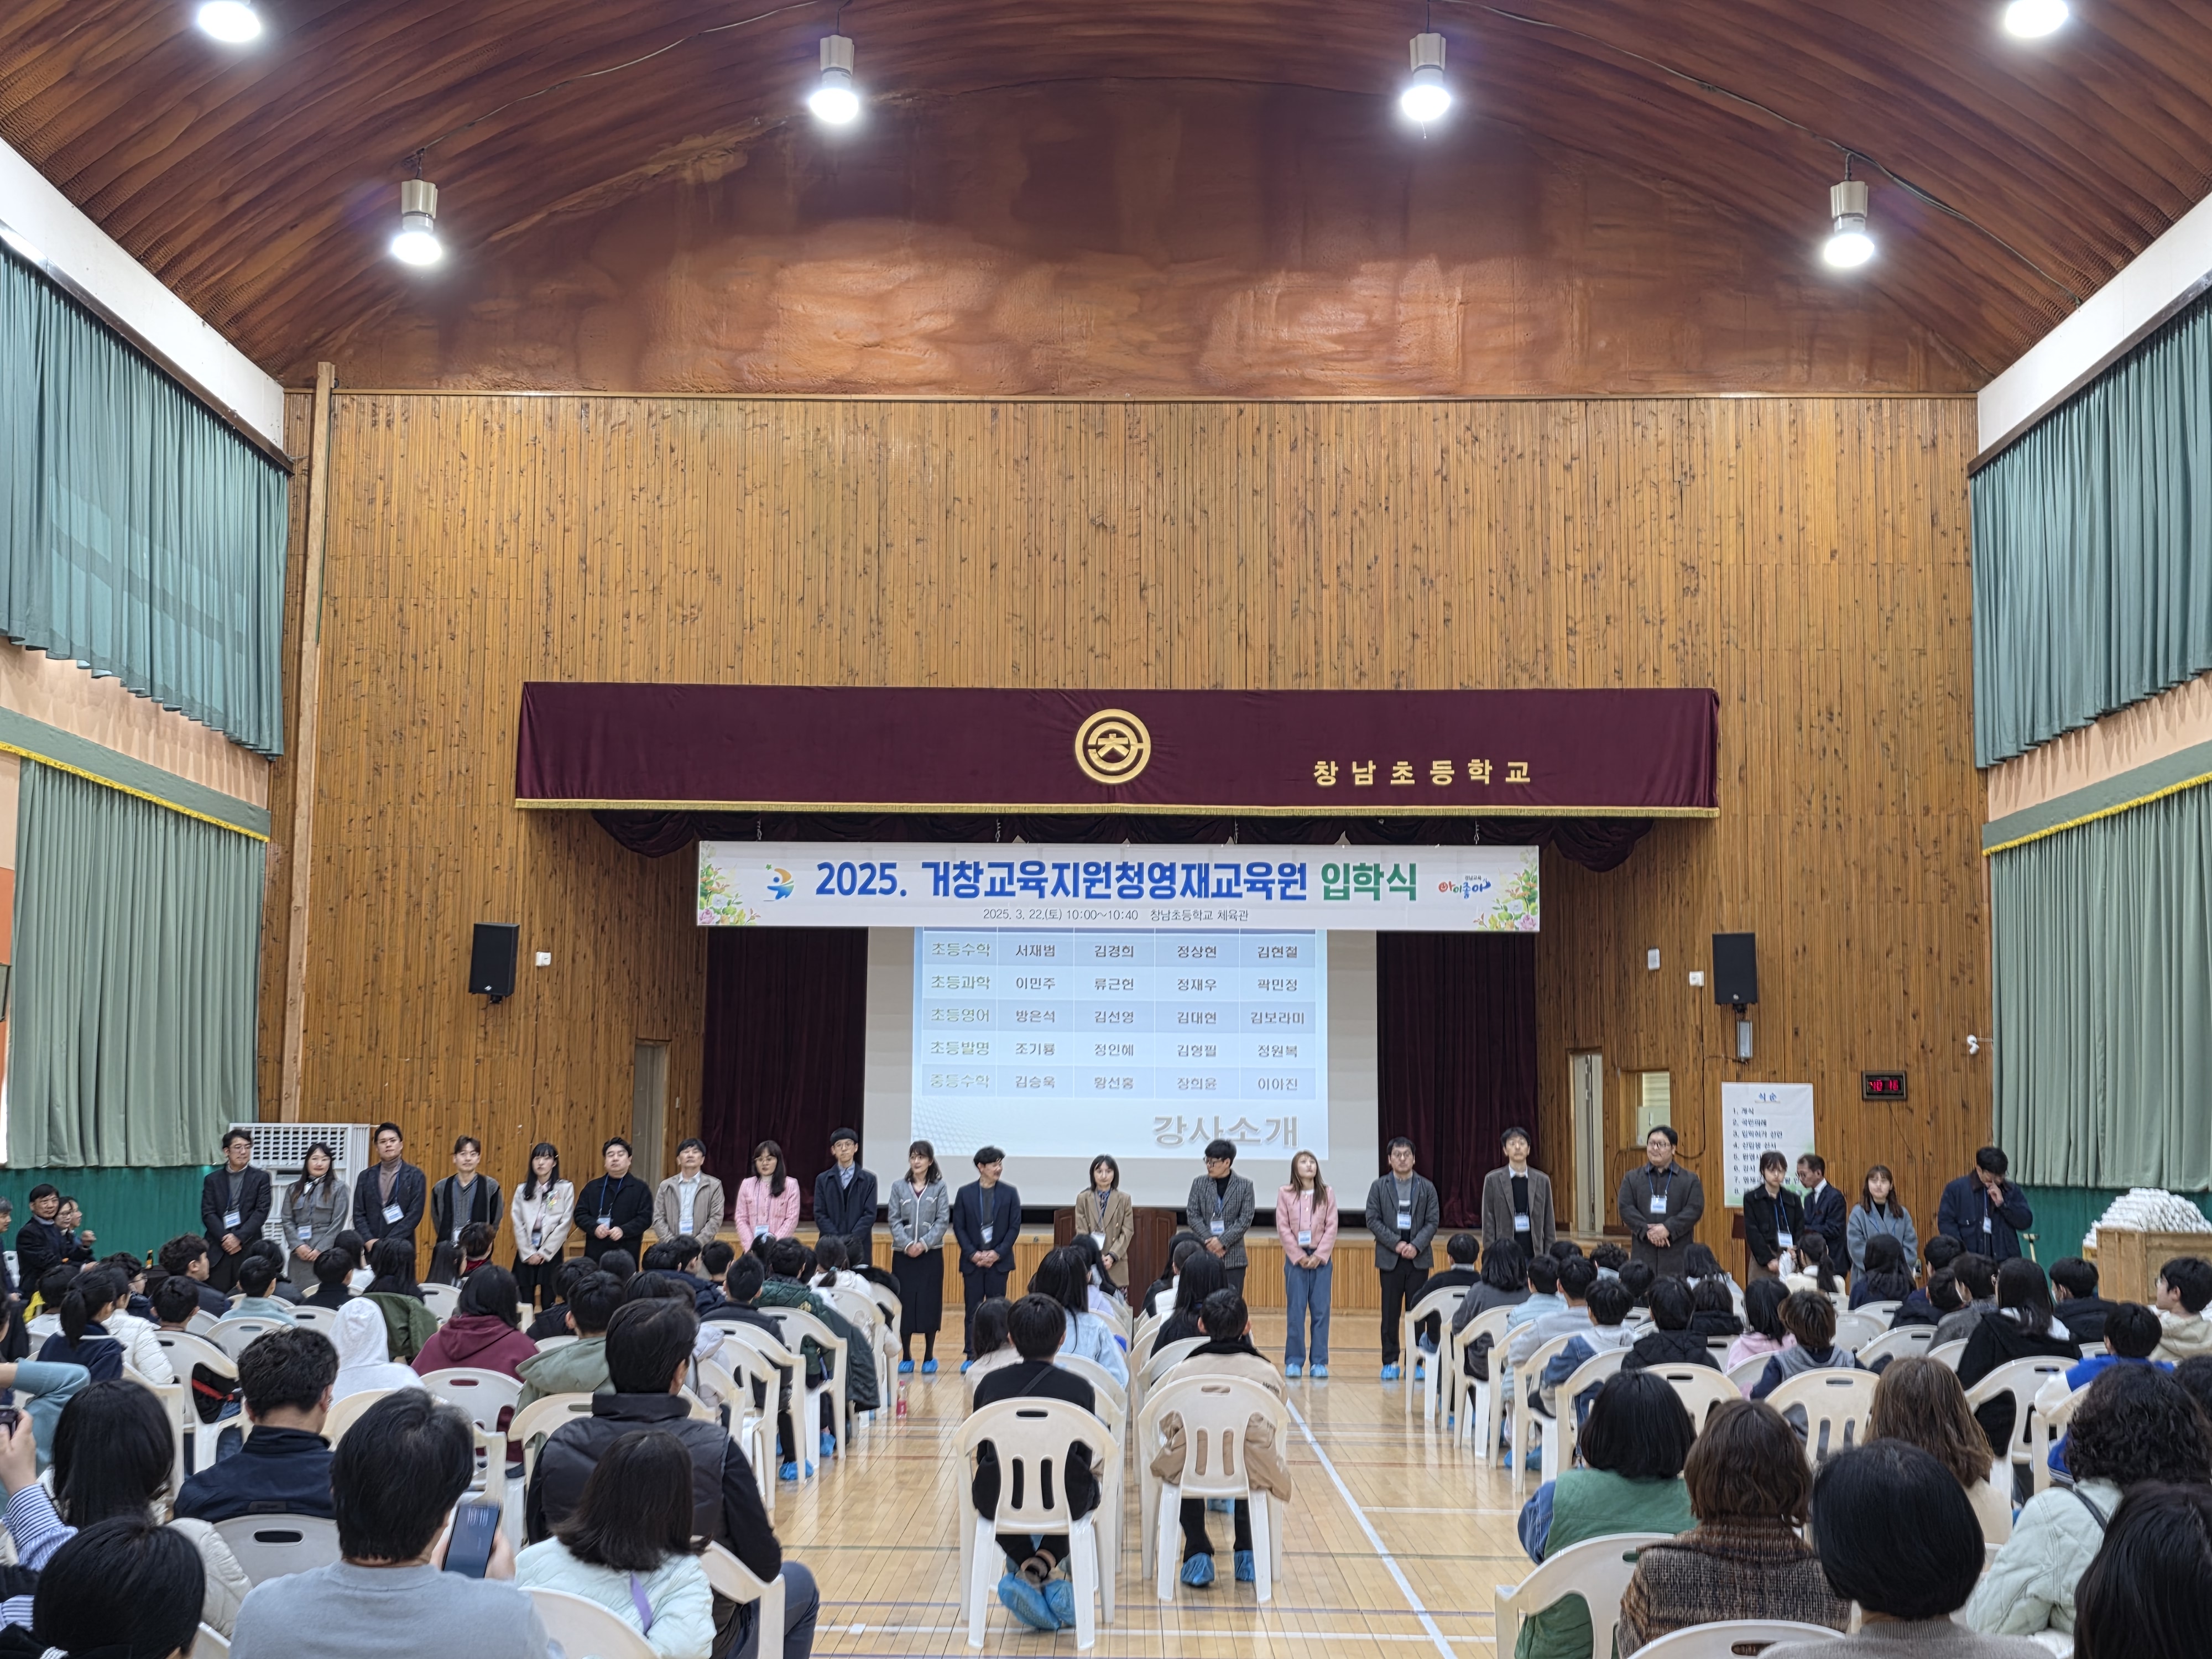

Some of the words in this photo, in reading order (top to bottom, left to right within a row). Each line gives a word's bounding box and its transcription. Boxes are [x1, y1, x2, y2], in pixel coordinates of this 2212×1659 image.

[1314, 759, 1531, 786] 창남초등학교
[816, 862, 907, 897] 2025.
[922, 860, 1306, 901] 거창교육지원청영재교육원
[1321, 862, 1417, 901] 입학식
[983, 909, 1011, 920] 2025.
[1016, 909, 1025, 920] 3.
[1067, 909, 1138, 920] 10:00~10:40
[1150, 909, 1213, 922] 창남초등학교
[1217, 909, 1249, 922] 체육관
[932, 943, 990, 957] 초등수학
[1016, 945, 1055, 957] 서재범
[1095, 946, 1133, 957] 김경희
[1178, 946, 1216, 958] 정상현
[1258, 946, 1297, 958] 김현철
[931, 975, 990, 989] 초등과학
[1016, 978, 1055, 989] 이민주
[1178, 979, 1216, 991] 정재우
[1258, 979, 1297, 991] 곽민정
[931, 1008, 989, 1022] 초등영어
[1016, 1010, 1055, 1022] 방은석
[1095, 1011, 1133, 1023] 김선영
[1178, 1012, 1216, 1024] 김대현
[1251, 1012, 1303, 1024] 김보라미
[931, 1041, 989, 1055] 초등발명
[931, 1074, 989, 1088] 중등수학
[1258, 1078, 1297, 1091] 이아진
[1154, 1114, 1298, 1148] 강사소개
